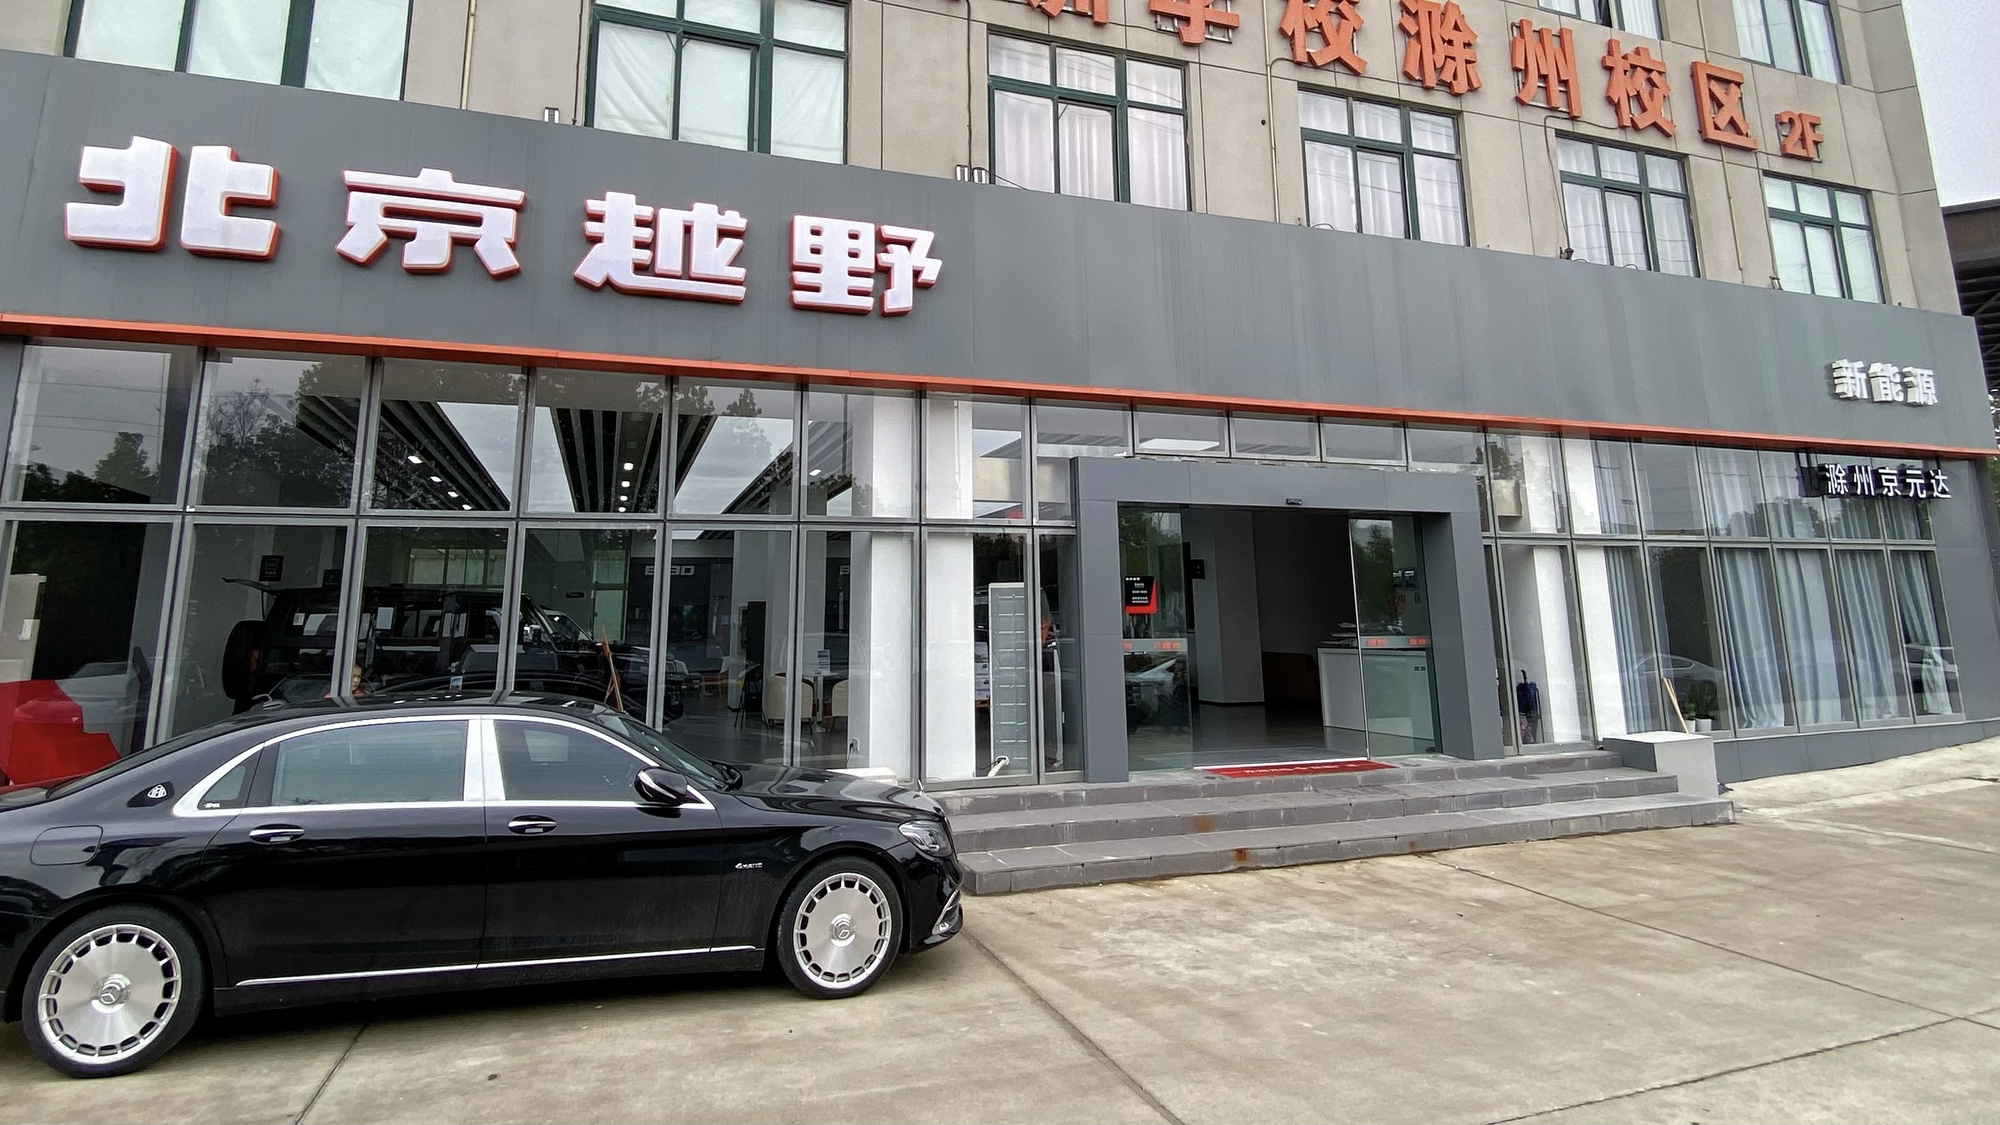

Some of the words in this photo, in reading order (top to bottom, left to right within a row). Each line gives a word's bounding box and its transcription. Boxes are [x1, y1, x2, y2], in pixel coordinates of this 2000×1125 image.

[1776, 110, 1824, 161] 2F
[64, 135, 943, 317] 北京越野
[1831, 358, 1939, 406] 新能源
[1824, 463, 1952, 499] 滁州京元达
